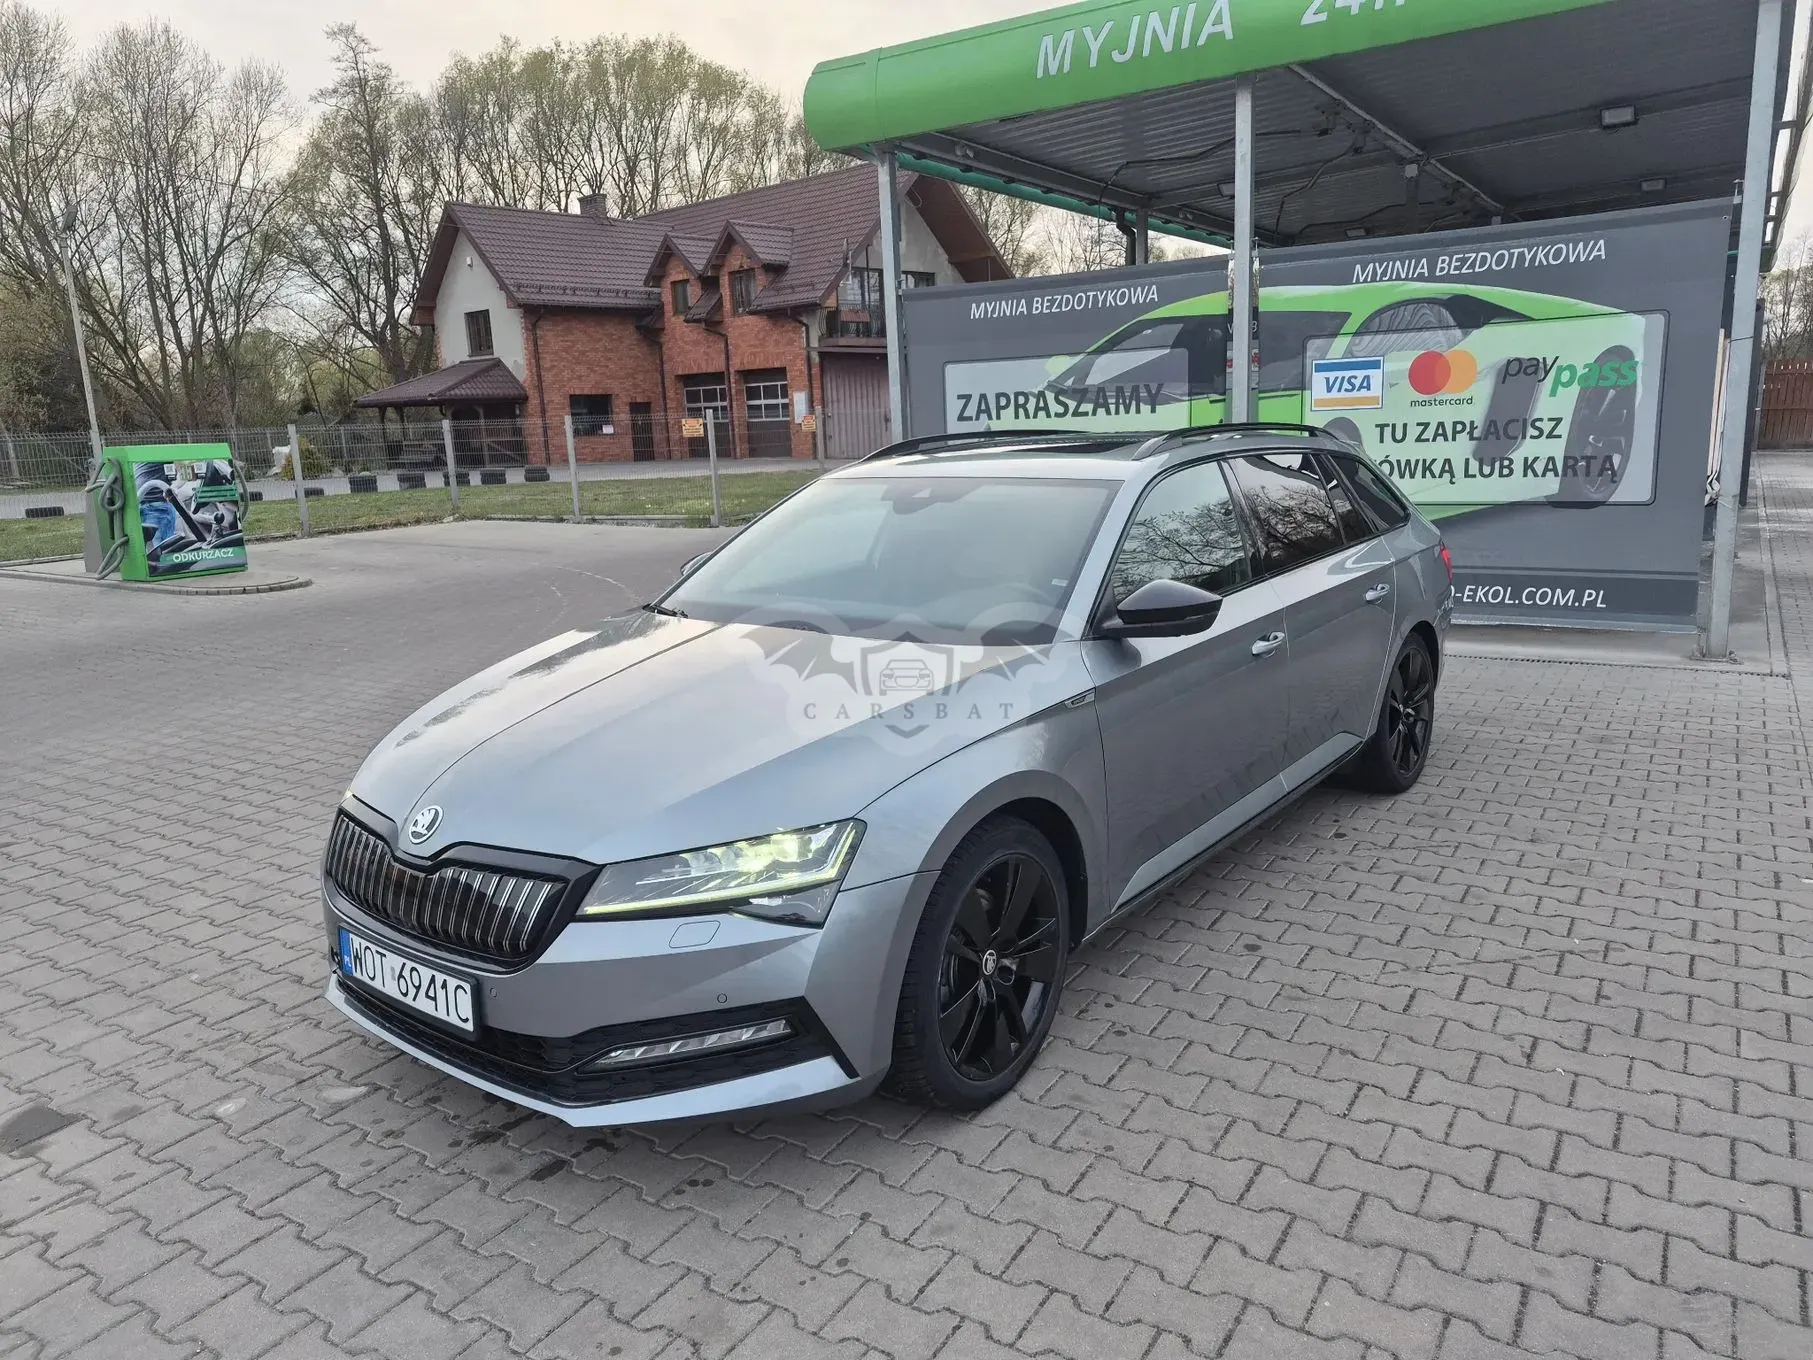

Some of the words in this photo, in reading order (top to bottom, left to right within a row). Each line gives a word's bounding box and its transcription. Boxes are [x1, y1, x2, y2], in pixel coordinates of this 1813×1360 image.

[1036, 0, 1235, 79] MYJNIA
[1352, 256, 1429, 284] MYJNIA
[1434, 239, 1607, 275] BEZDOTYKOWA
[970, 302, 1027, 320] MYJNIA
[1031, 284, 1159, 315] BEZDOTYKOWA
[1323, 373, 1372, 395] VISA
[956, 383, 1164, 422] ZAPRASZAMY
[1409, 396, 1474, 408] mastercard
[1375, 422, 1408, 444] TU
[1414, 416, 1563, 443] ZAPŁACISZ
[1374, 454, 1456, 485] ÓWKĄ
[1463, 456, 1515, 478] LUB
[1522, 454, 1618, 484] KARTĄ
[173, 548, 234, 562] ODKURZACZ
[1451, 585, 1607, 608] -EKOL.COM.PL
[350, 937, 387, 988] WOT
[397, 962, 470, 1023] 6941C
